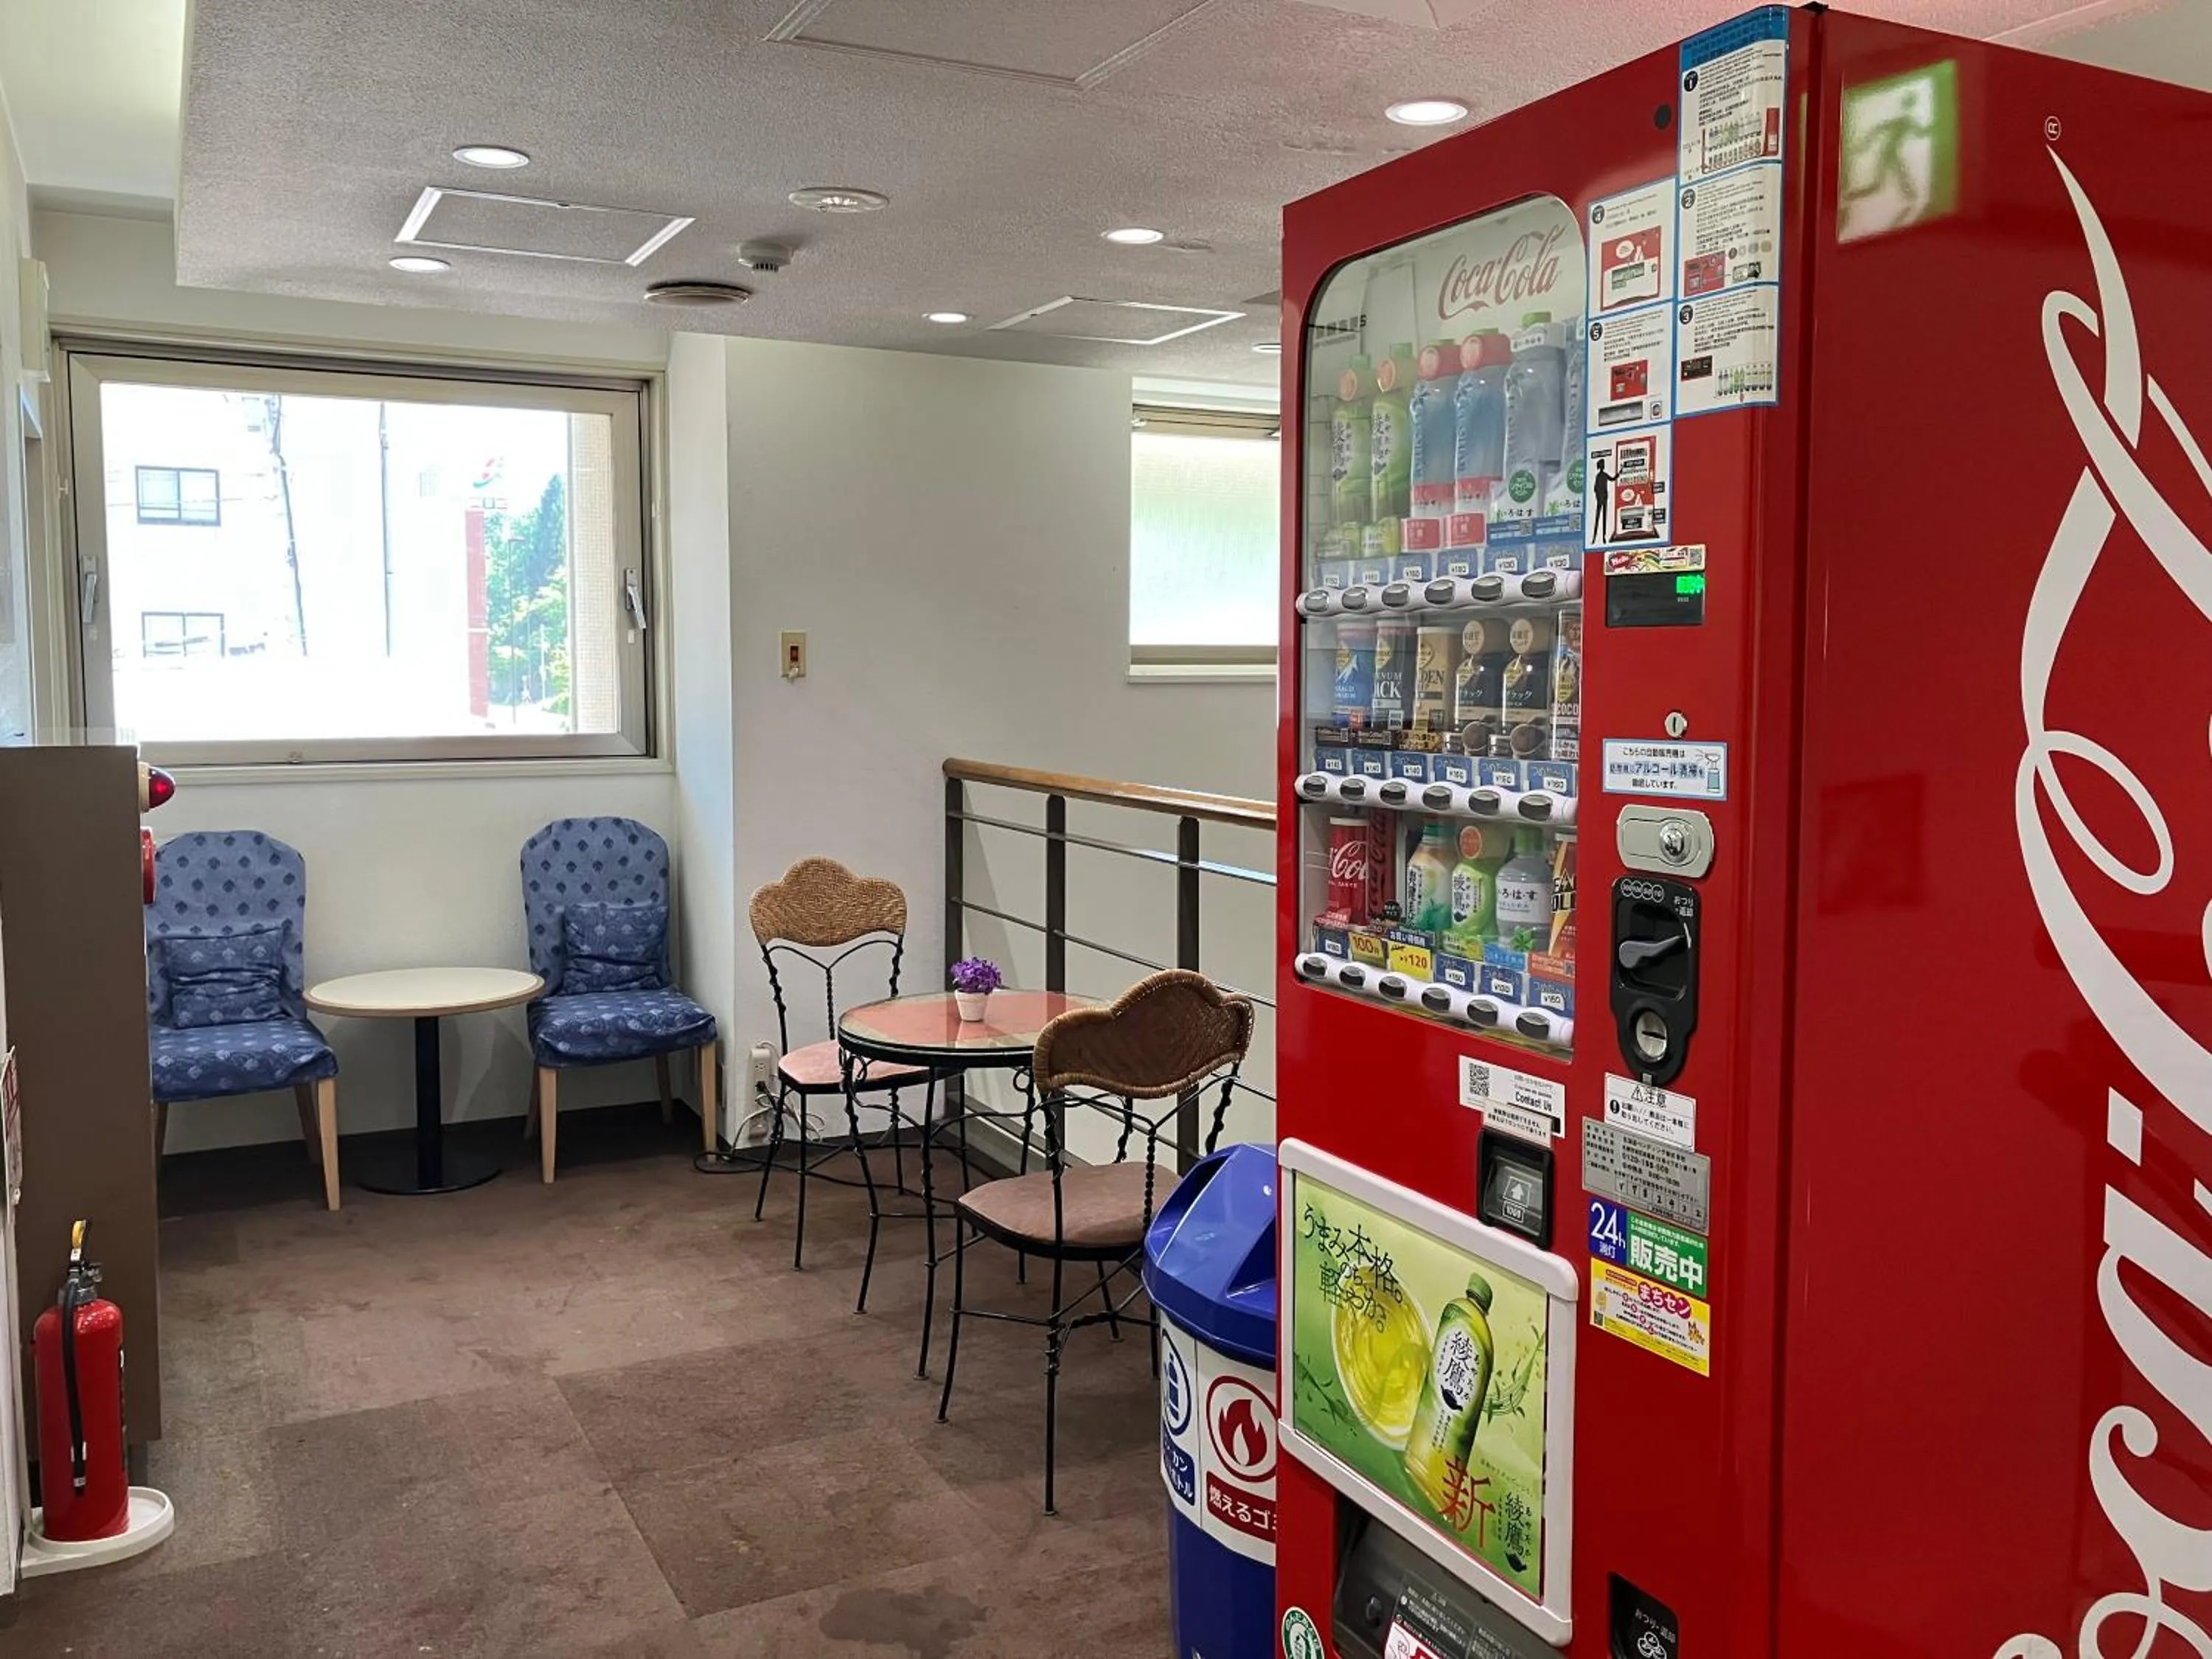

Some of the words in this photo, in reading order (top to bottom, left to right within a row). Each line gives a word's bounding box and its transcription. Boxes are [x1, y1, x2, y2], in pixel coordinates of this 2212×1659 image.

[1439, 224, 1566, 319] Coca-Cola
[1514, 1091, 1542, 1109] Contact
[1630, 1234, 1704, 1290] 販売中
[1639, 1282, 1691, 1318] まちセン
[1439, 1455, 1495, 1548] 新
